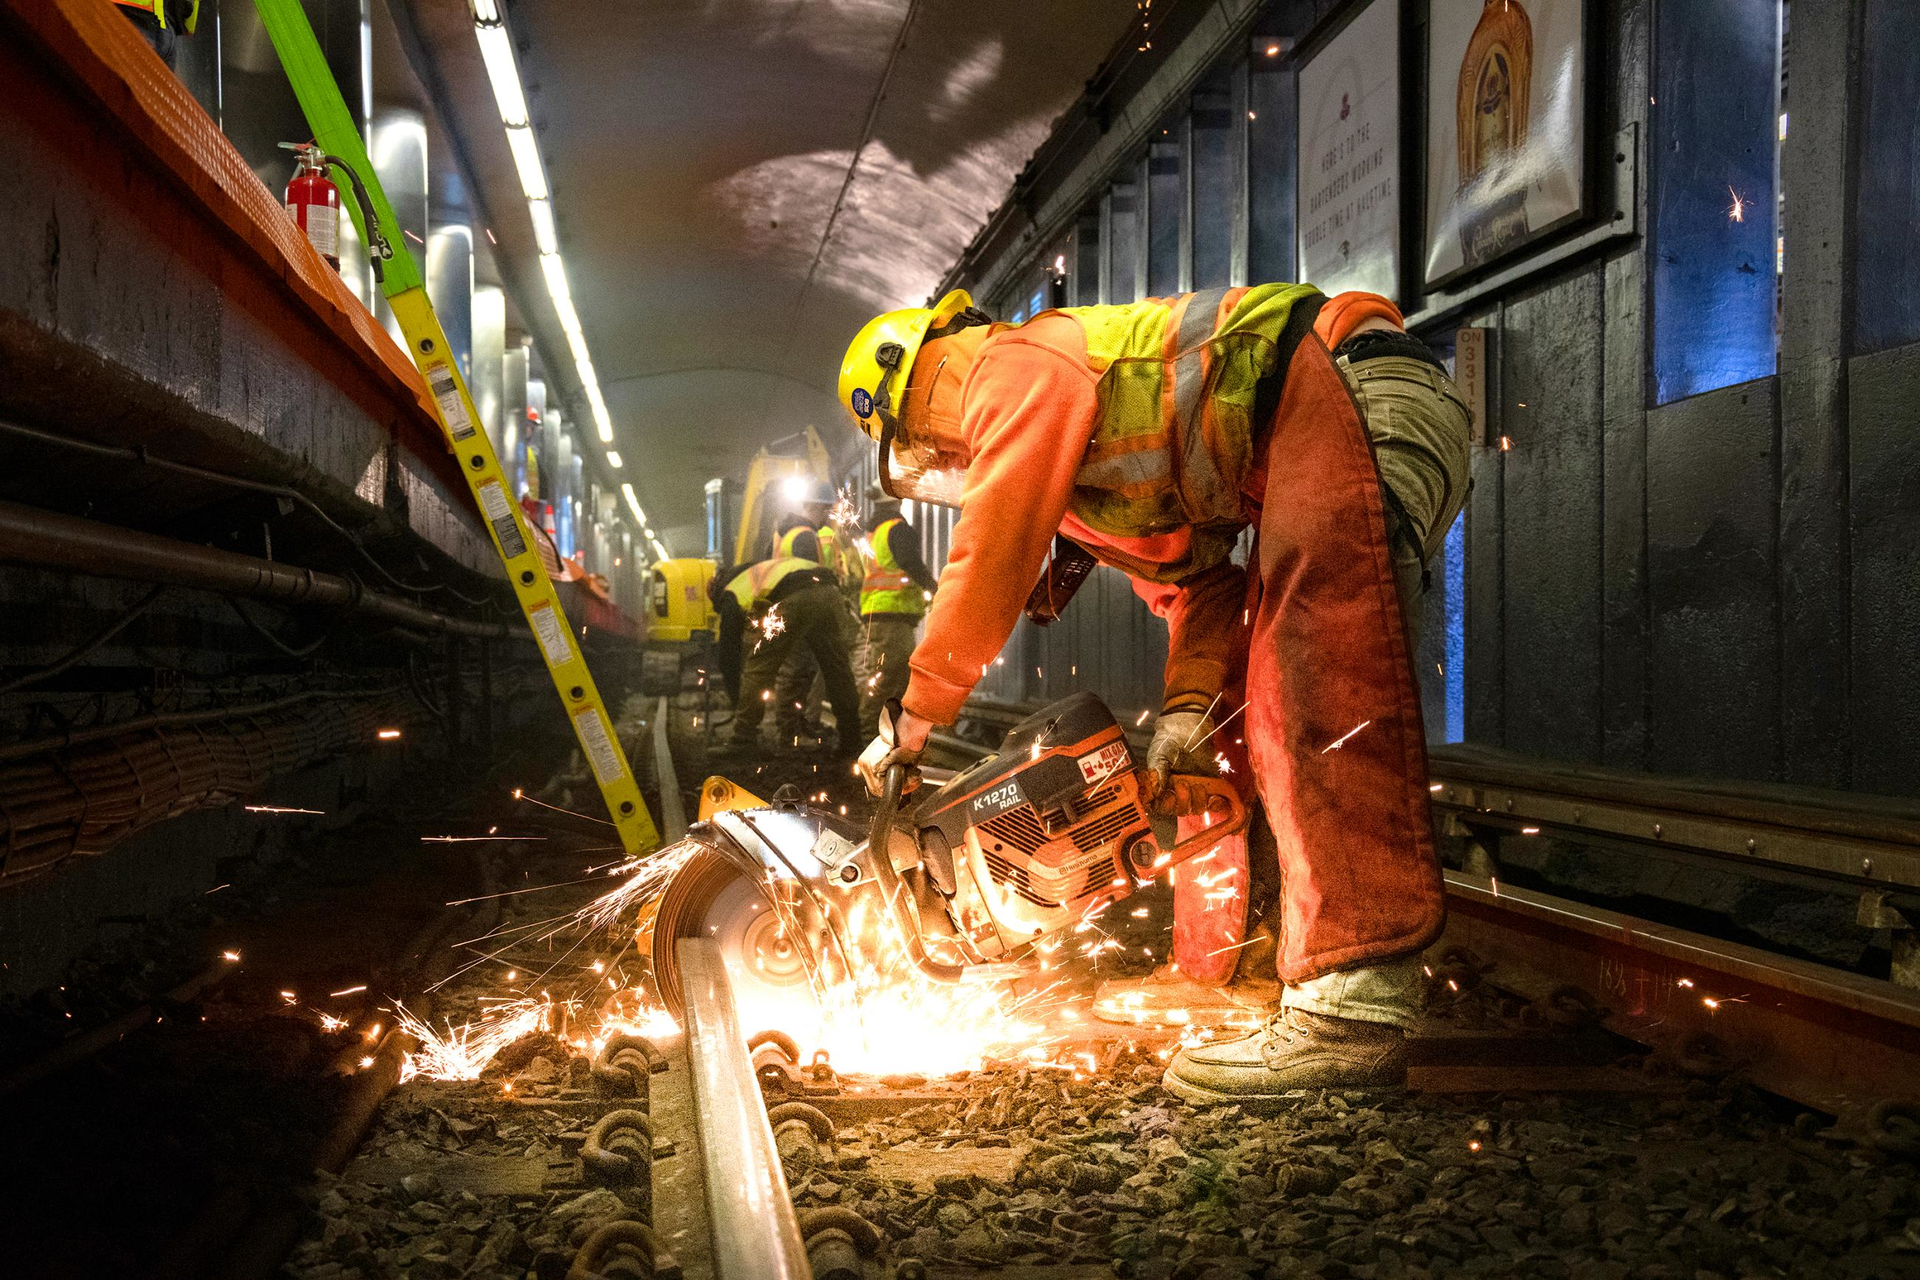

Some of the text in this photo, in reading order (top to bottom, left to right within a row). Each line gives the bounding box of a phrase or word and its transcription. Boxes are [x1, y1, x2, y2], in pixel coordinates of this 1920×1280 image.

[1460, 331, 1481, 343] ON
[973, 783, 1017, 811] K1270
[999, 794, 1022, 810] RAIL
